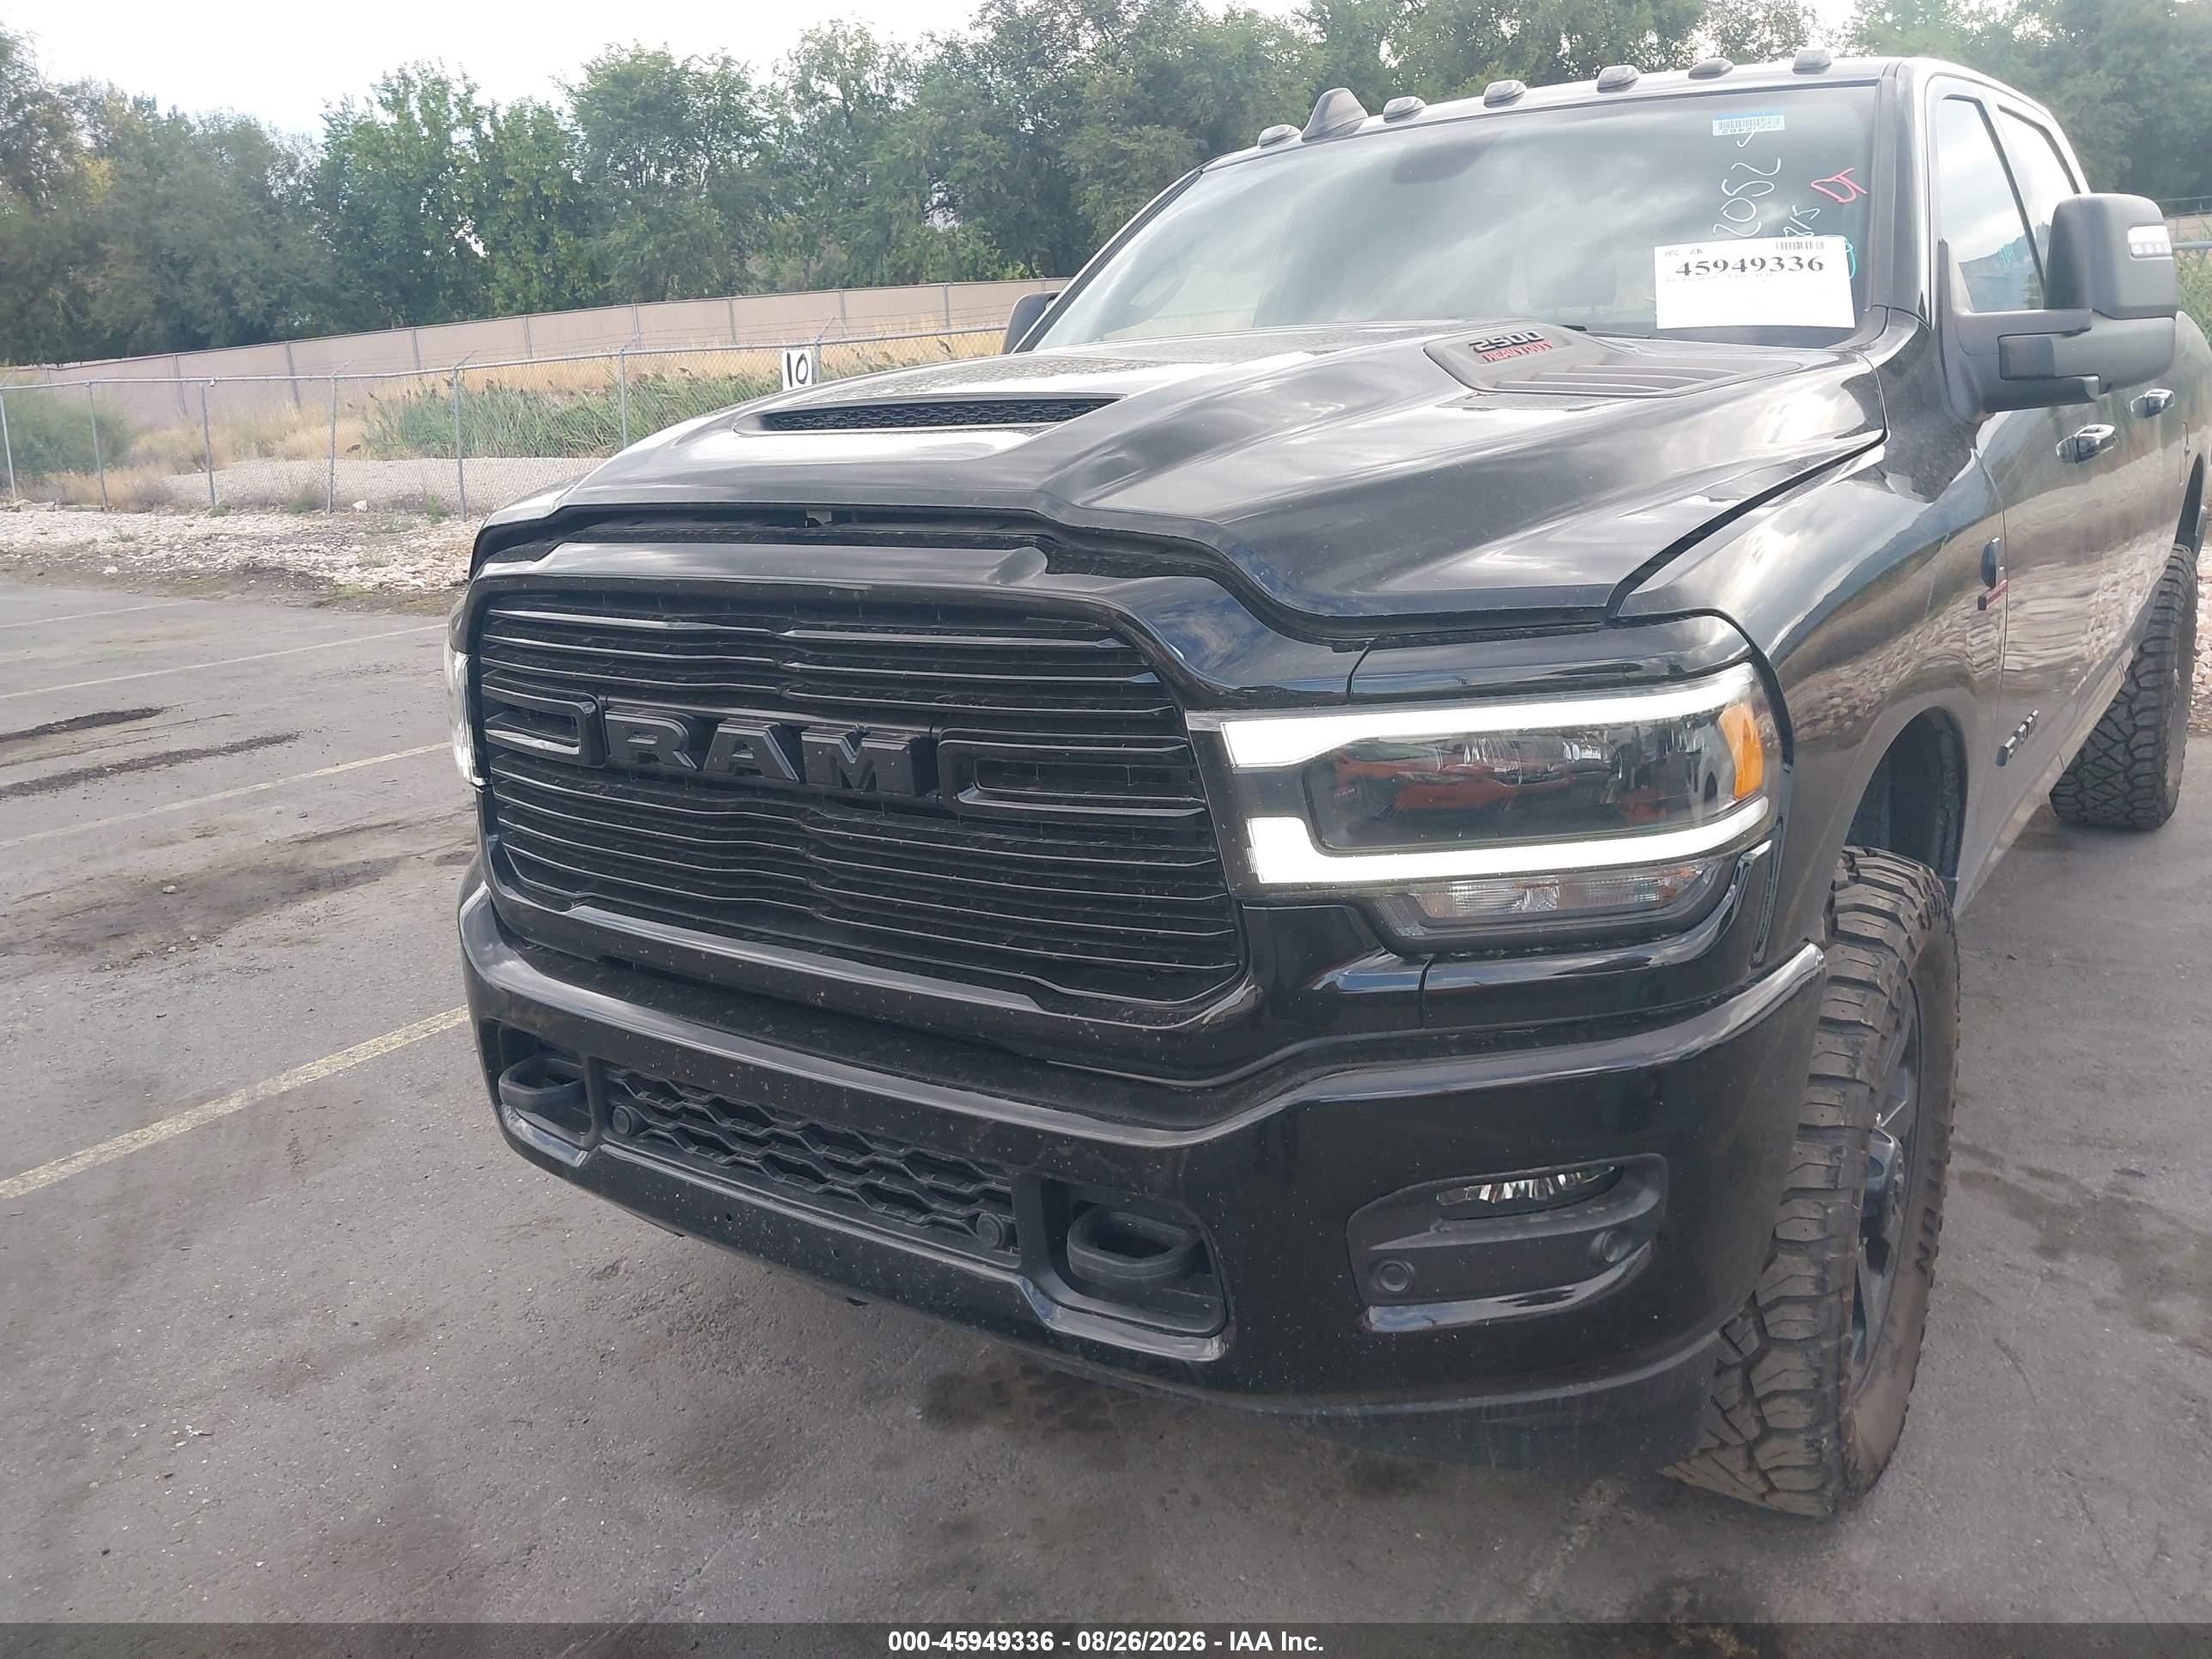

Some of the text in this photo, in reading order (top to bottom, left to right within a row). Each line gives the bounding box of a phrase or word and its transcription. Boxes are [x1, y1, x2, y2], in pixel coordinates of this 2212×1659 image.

[1674, 256, 1825, 276] 45949336
[1468, 330, 1545, 353] 2500
[1482, 342, 1553, 362] HEAVY DUTY
[787, 352, 809, 388] 10
[605, 705, 936, 797] RAM
